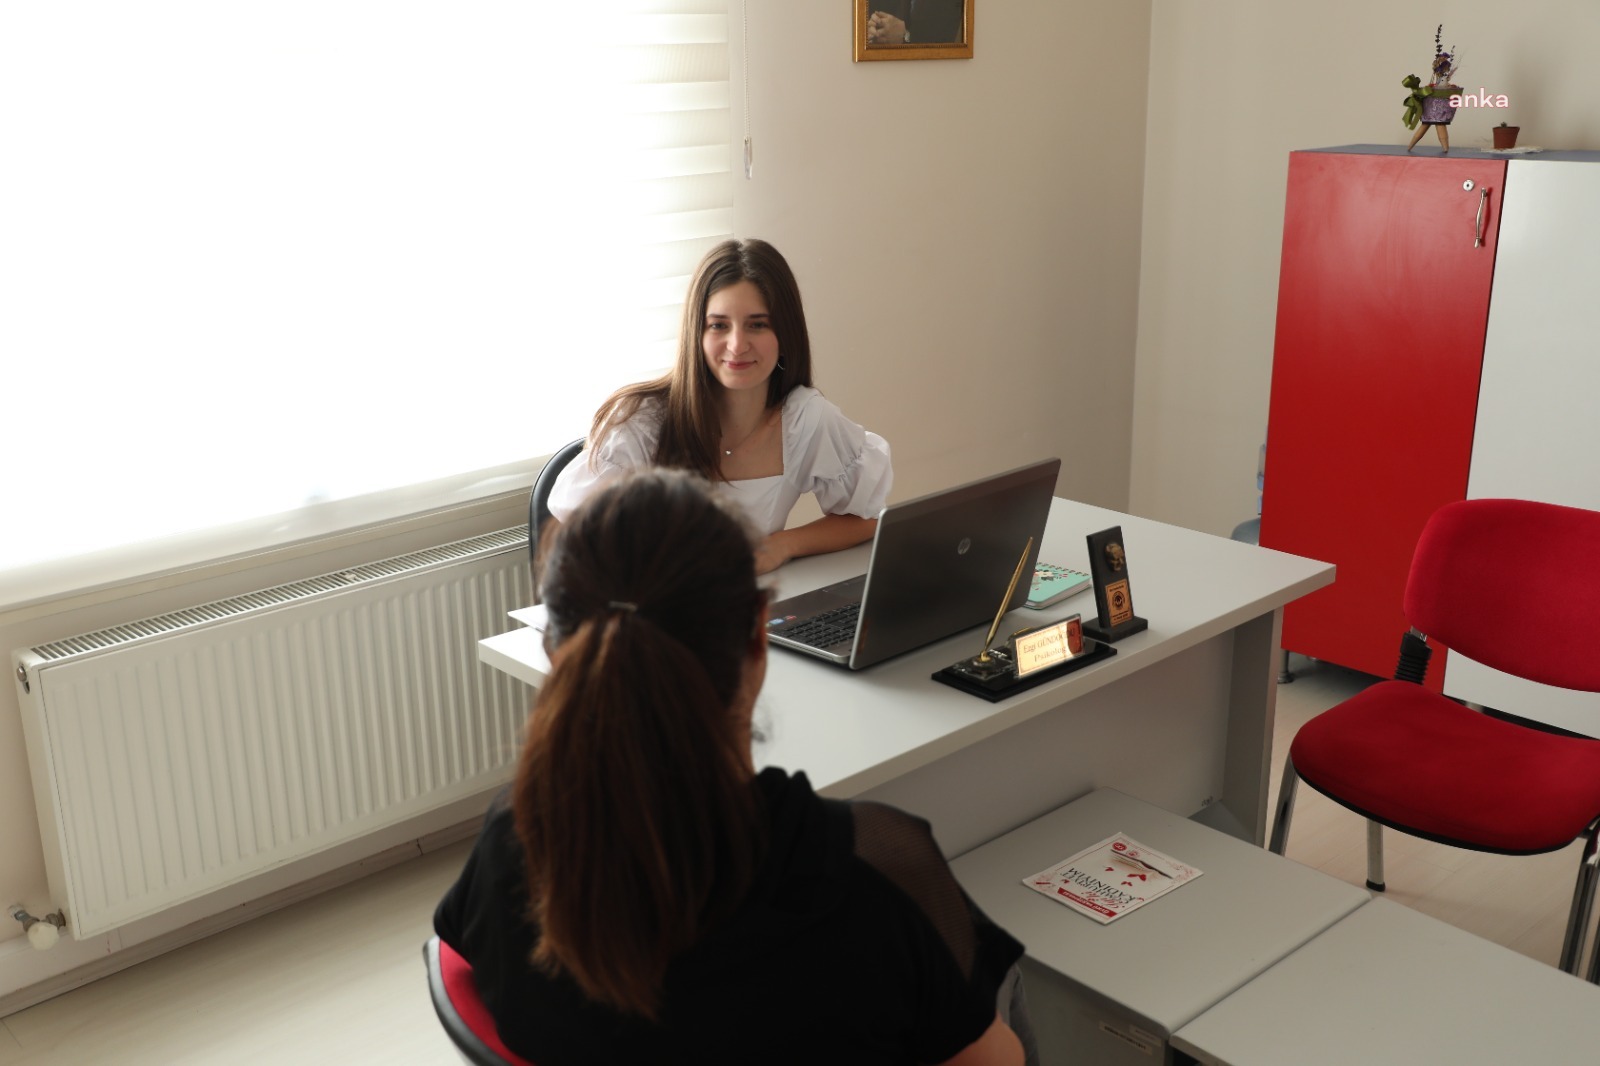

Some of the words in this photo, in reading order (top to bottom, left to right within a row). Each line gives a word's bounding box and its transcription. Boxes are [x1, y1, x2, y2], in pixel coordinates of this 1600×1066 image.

[1023, 644, 1036, 654] Ezgi
[1034, 646, 1067, 663] Psikolog
[1068, 867, 1136, 902] KADINIYIM
